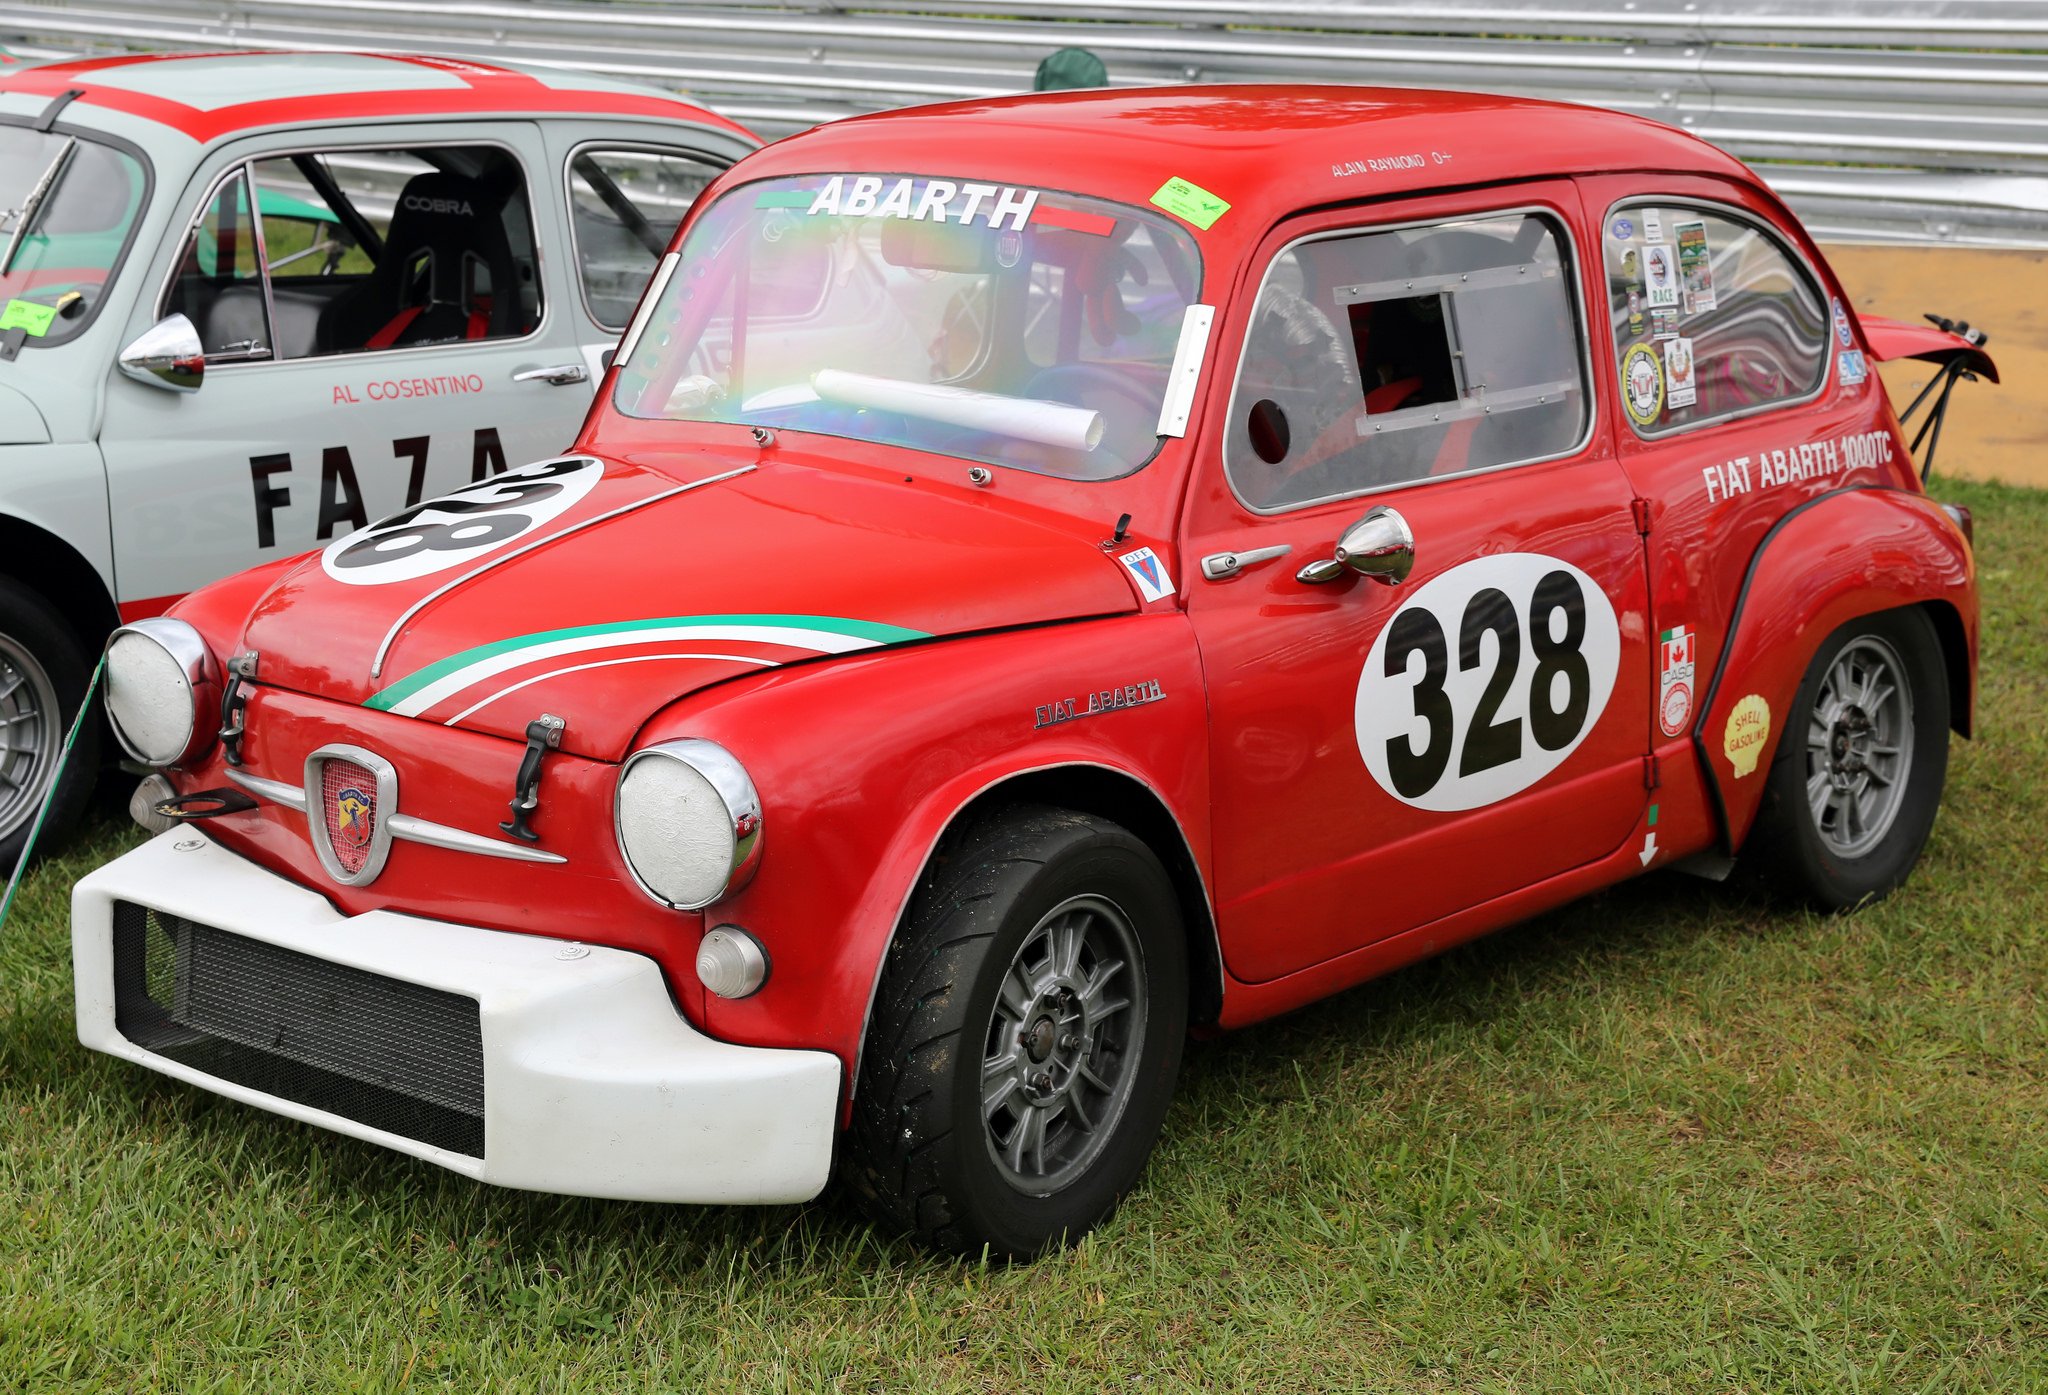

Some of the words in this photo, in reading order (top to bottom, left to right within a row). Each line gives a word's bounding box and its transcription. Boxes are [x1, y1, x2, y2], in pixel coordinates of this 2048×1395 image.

[1331, 160, 1368, 177] ALAIN
[1367, 153, 1425, 172] RAYMOND
[404, 196, 474, 216] COBRA
[807, 176, 1040, 231] ABARTH
[1652, 288, 1673, 304] RACE
[332, 385, 361, 404] AL
[367, 374, 484, 401] COSENTINO
[1702, 456, 1752, 503] FIAT
[1760, 439, 1839, 489] ABARTH
[1840, 430, 1893, 470] 1000TC
[1125, 549, 1149, 563] OFF
[1384, 570, 1590, 799] 328
[1662, 664, 1694, 686] CASC
[1034, 697, 1076, 728] FIAT
[1087, 679, 1167, 713] ABARTH
[1735, 711, 1760, 732] SHELL
[1729, 727, 1766, 752] GASOLINE
